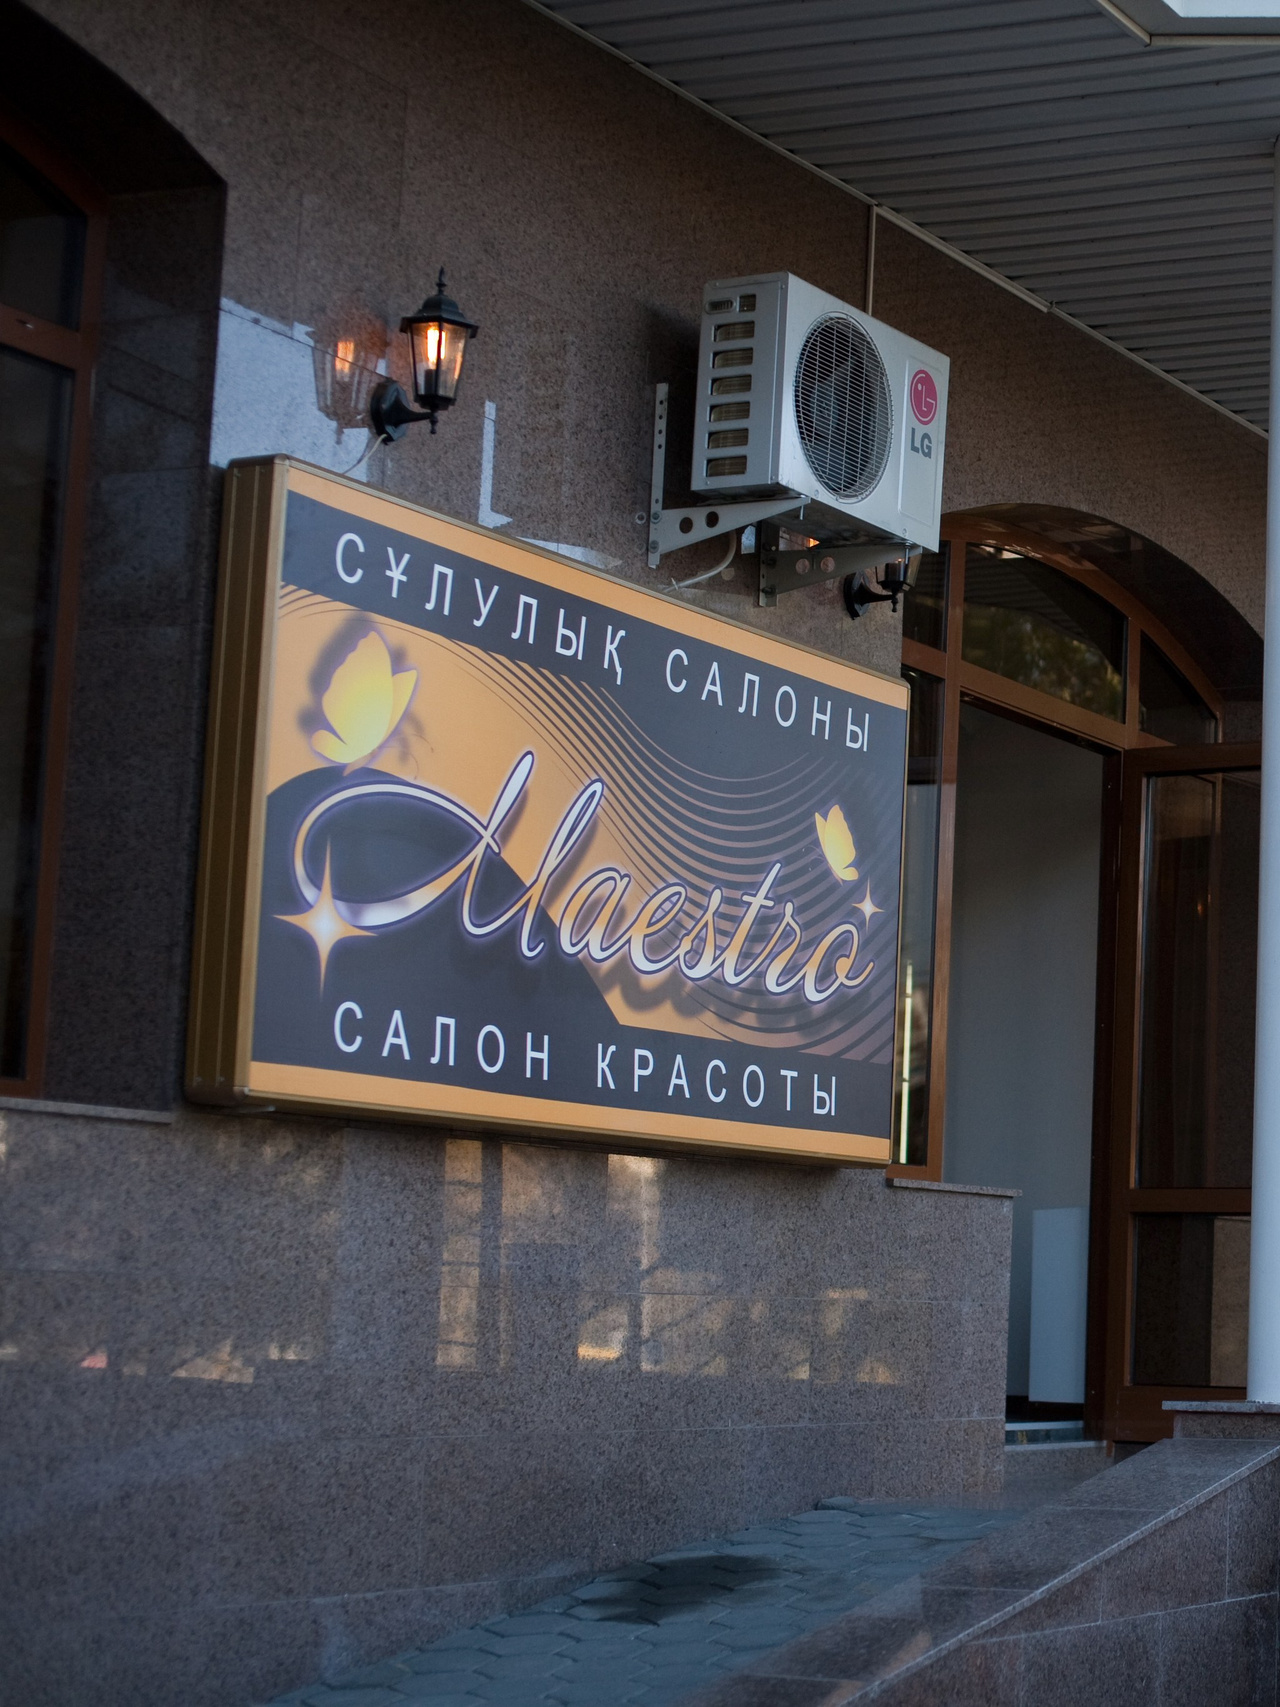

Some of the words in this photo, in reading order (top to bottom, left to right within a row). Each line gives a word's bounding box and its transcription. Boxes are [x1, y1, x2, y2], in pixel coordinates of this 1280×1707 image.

[911, 427, 932, 459] LG
[335, 533, 626, 685] СҰЛУЛЫҚ
[665, 649, 870, 752] САЛОНЫ
[294, 749, 875, 1003] Maestro
[334, 1001, 550, 1081] САЛОН
[597, 1042, 837, 1117] КРАСОТЫ
